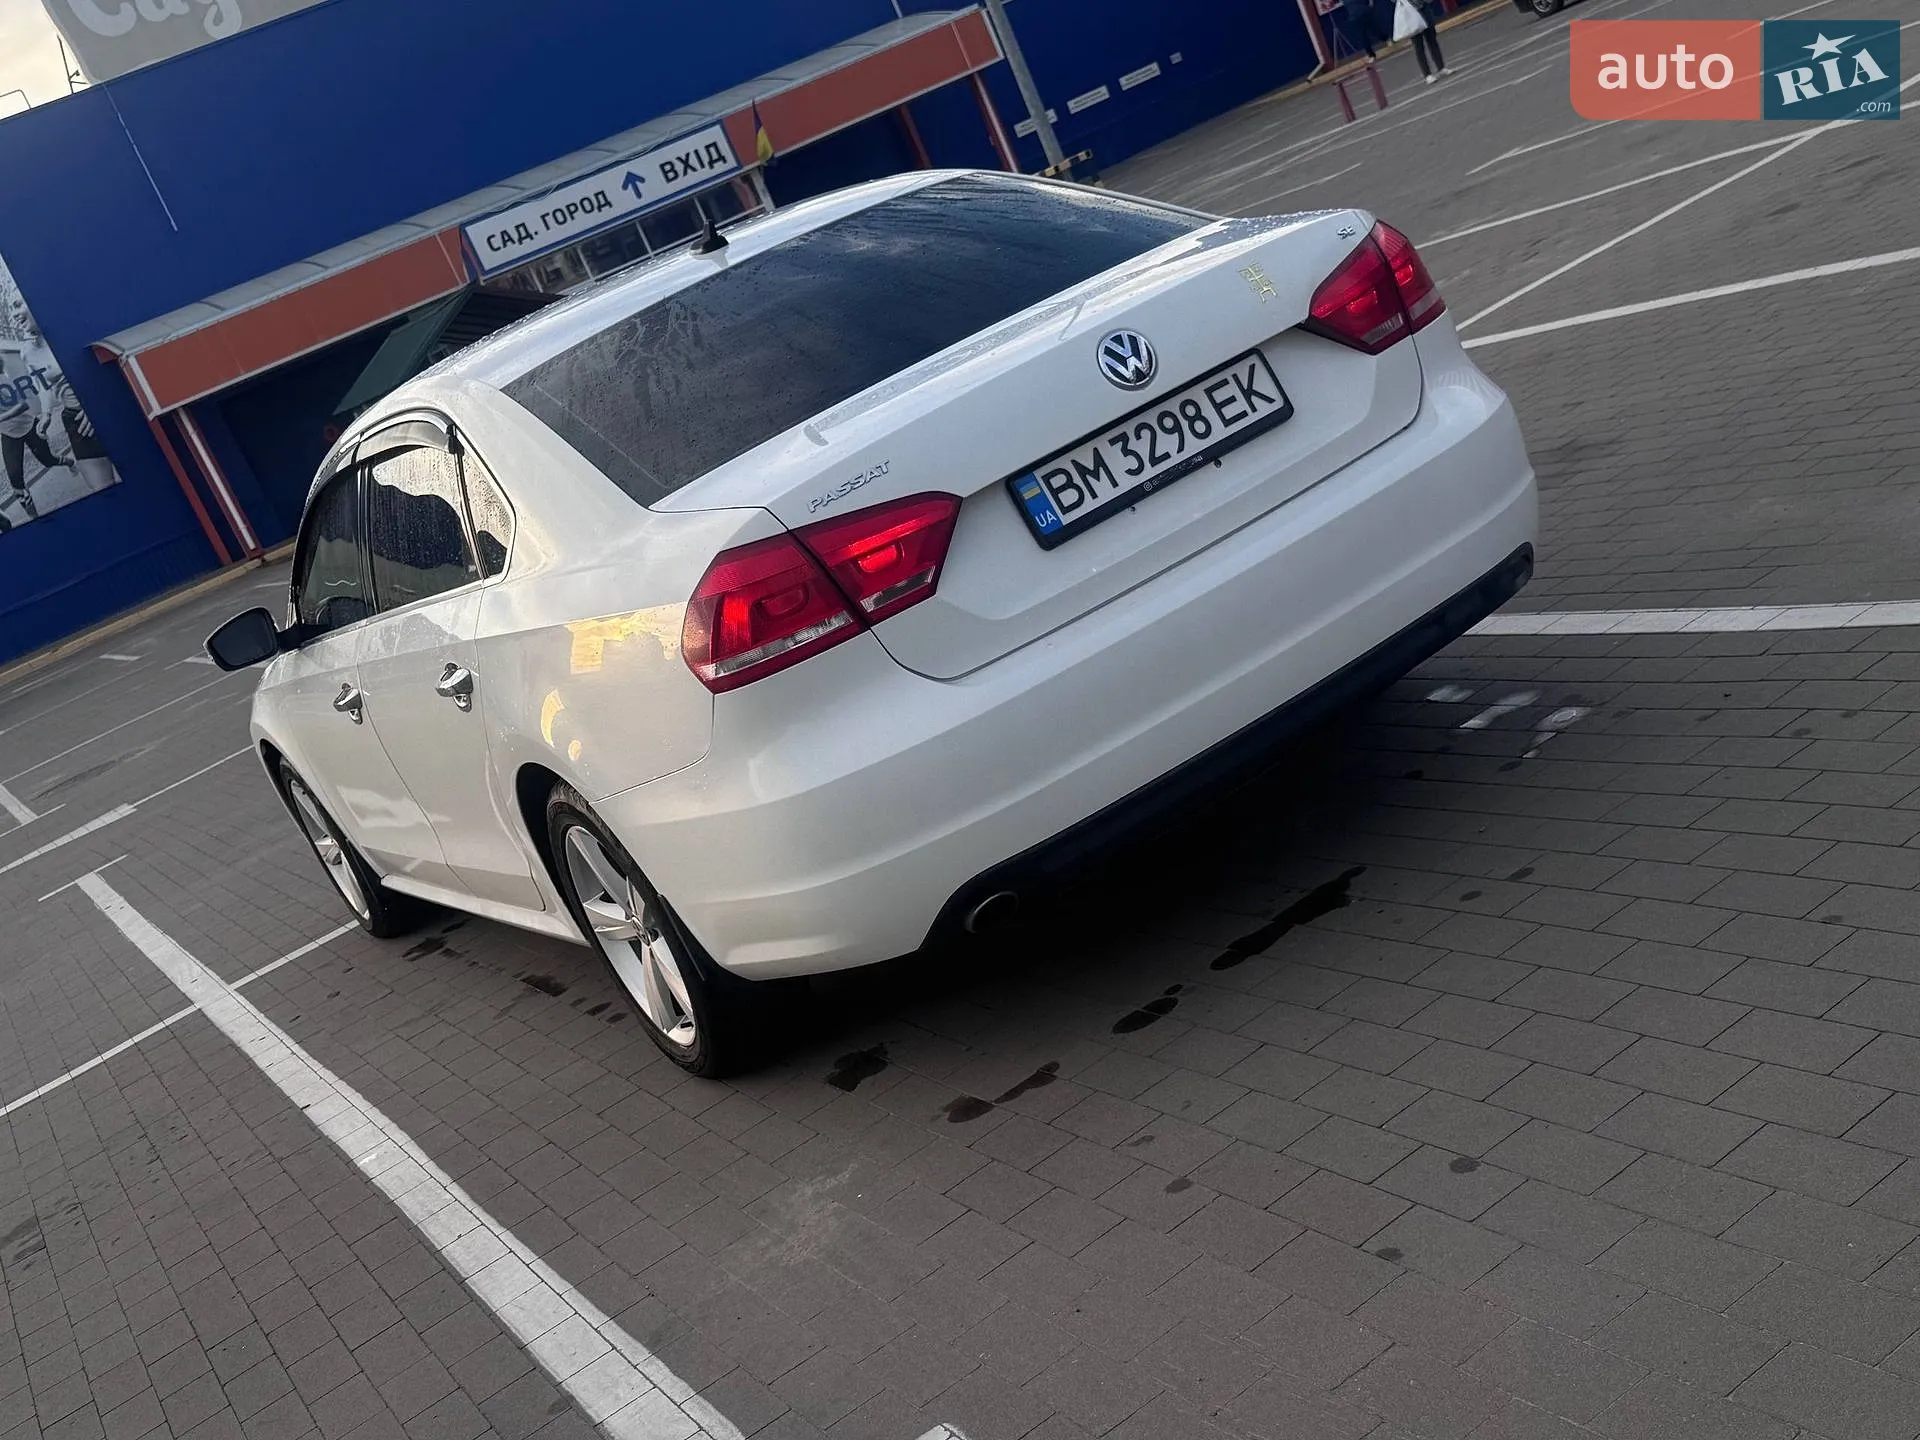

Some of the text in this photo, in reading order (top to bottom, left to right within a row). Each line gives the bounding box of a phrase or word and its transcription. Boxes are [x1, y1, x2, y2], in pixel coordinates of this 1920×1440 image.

[658, 141, 727, 184] ВХІД
[485, 190, 613, 252] САД. ГОРОД
[1108, 398, 1213, 477] 3298
[807, 459, 890, 514] PASSAT
[1035, 509, 1058, 529] UA
